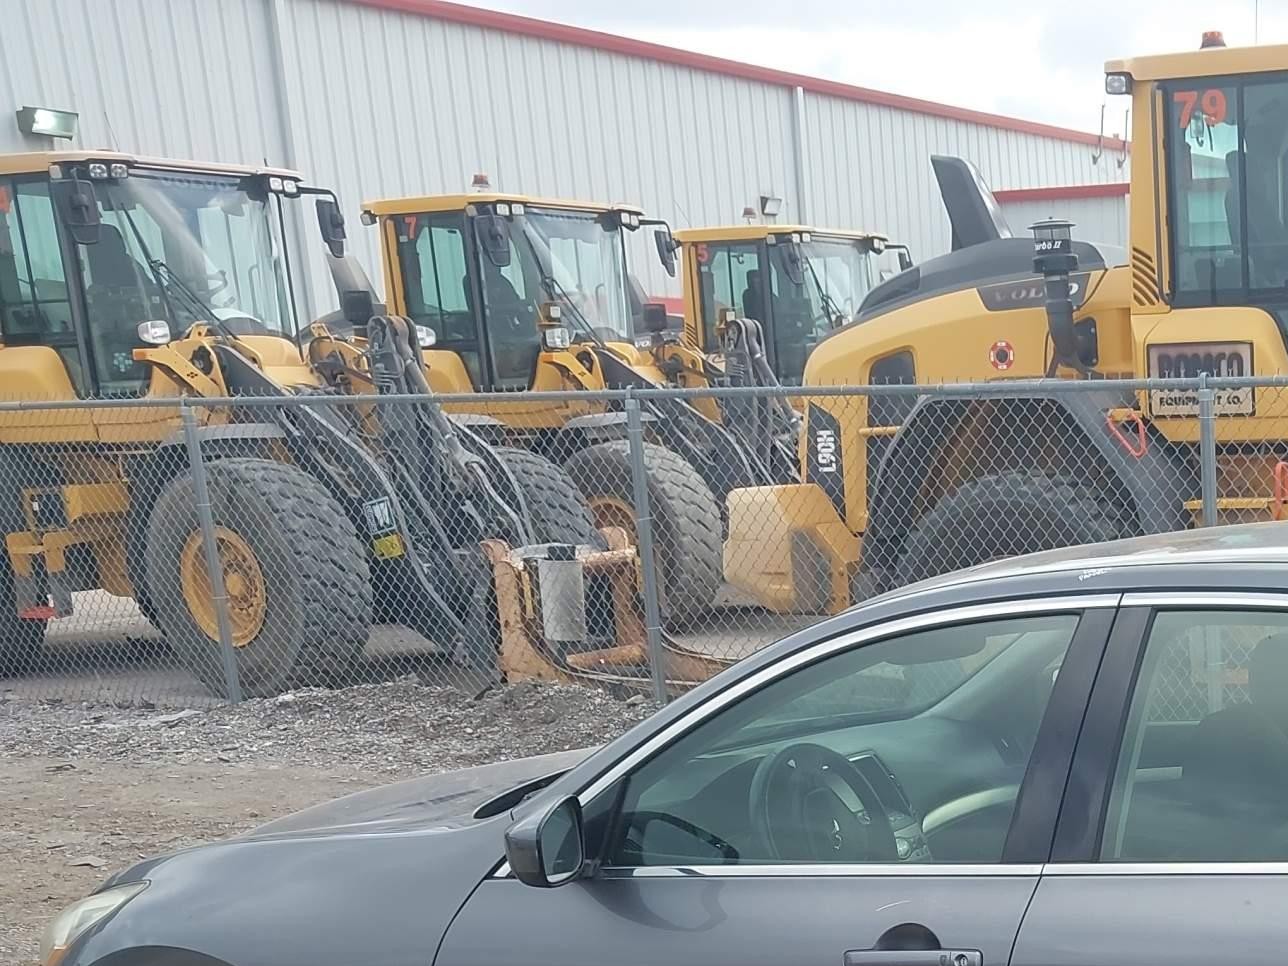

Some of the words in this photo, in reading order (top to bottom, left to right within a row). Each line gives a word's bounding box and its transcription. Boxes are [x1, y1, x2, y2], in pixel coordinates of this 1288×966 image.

[1173, 89, 1226, 128] 79
[404, 216, 417, 240] 7
[816, 430, 836, 473] L90H
